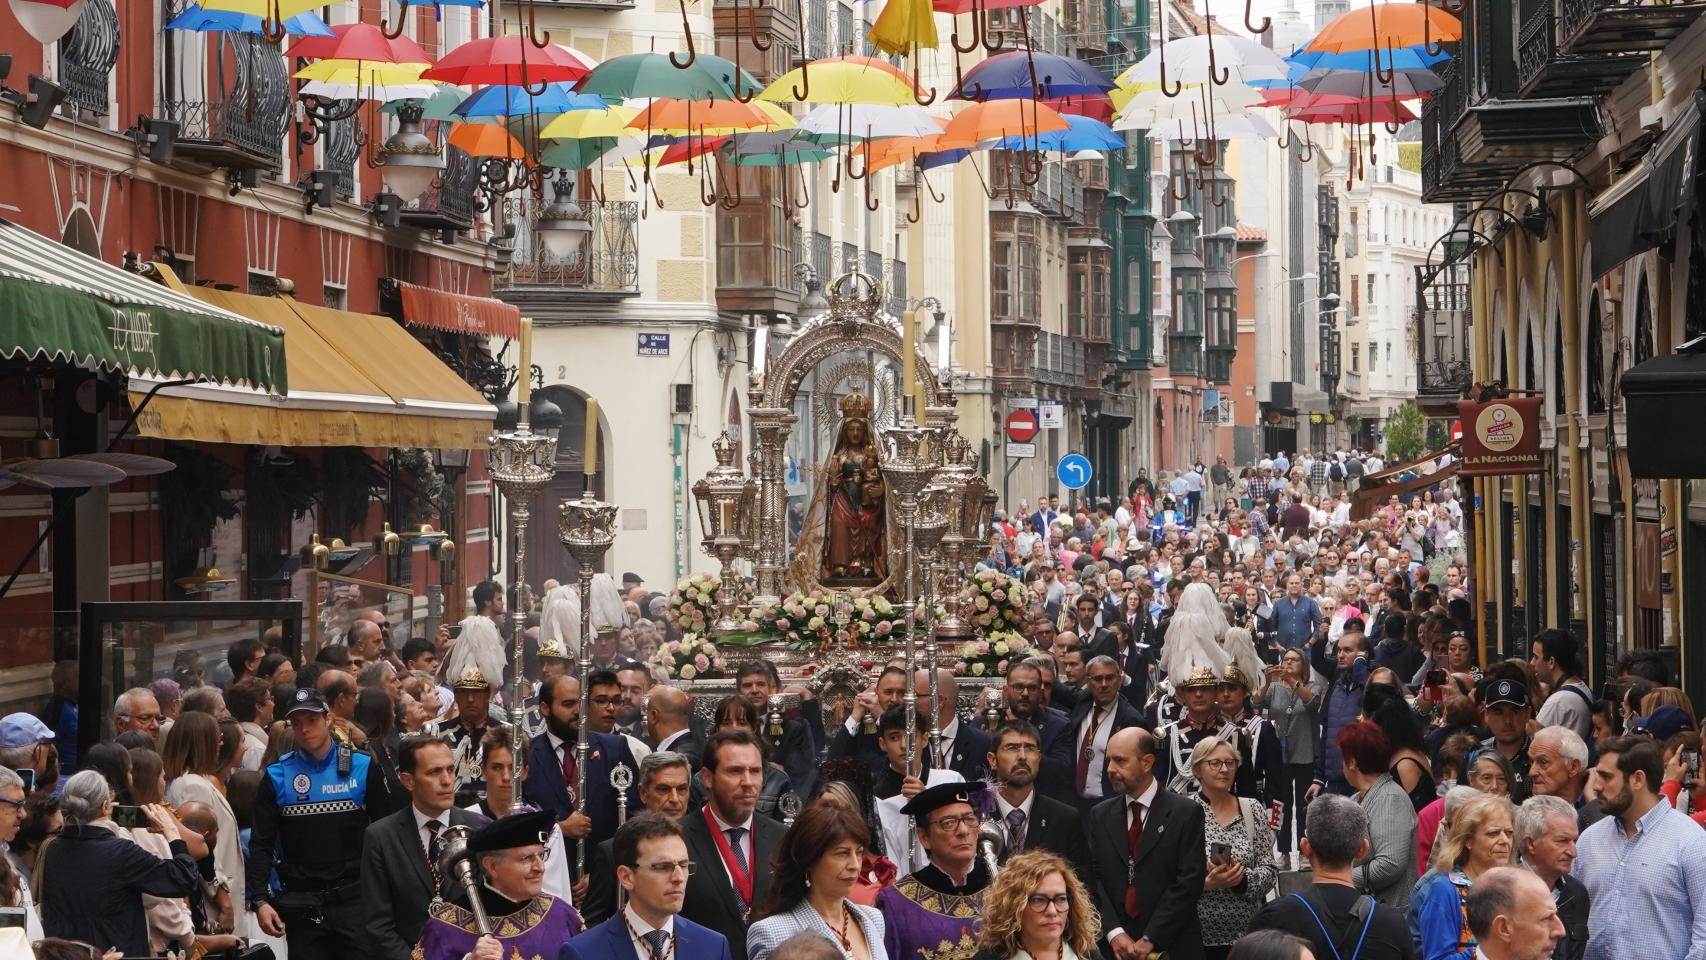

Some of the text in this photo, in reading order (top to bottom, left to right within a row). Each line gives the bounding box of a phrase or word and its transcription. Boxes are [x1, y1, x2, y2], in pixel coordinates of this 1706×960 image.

[558, 365, 566, 380] 2
[1481, 454, 1540, 464] NACIONAL
[322, 782, 349, 794] POLICÍA
